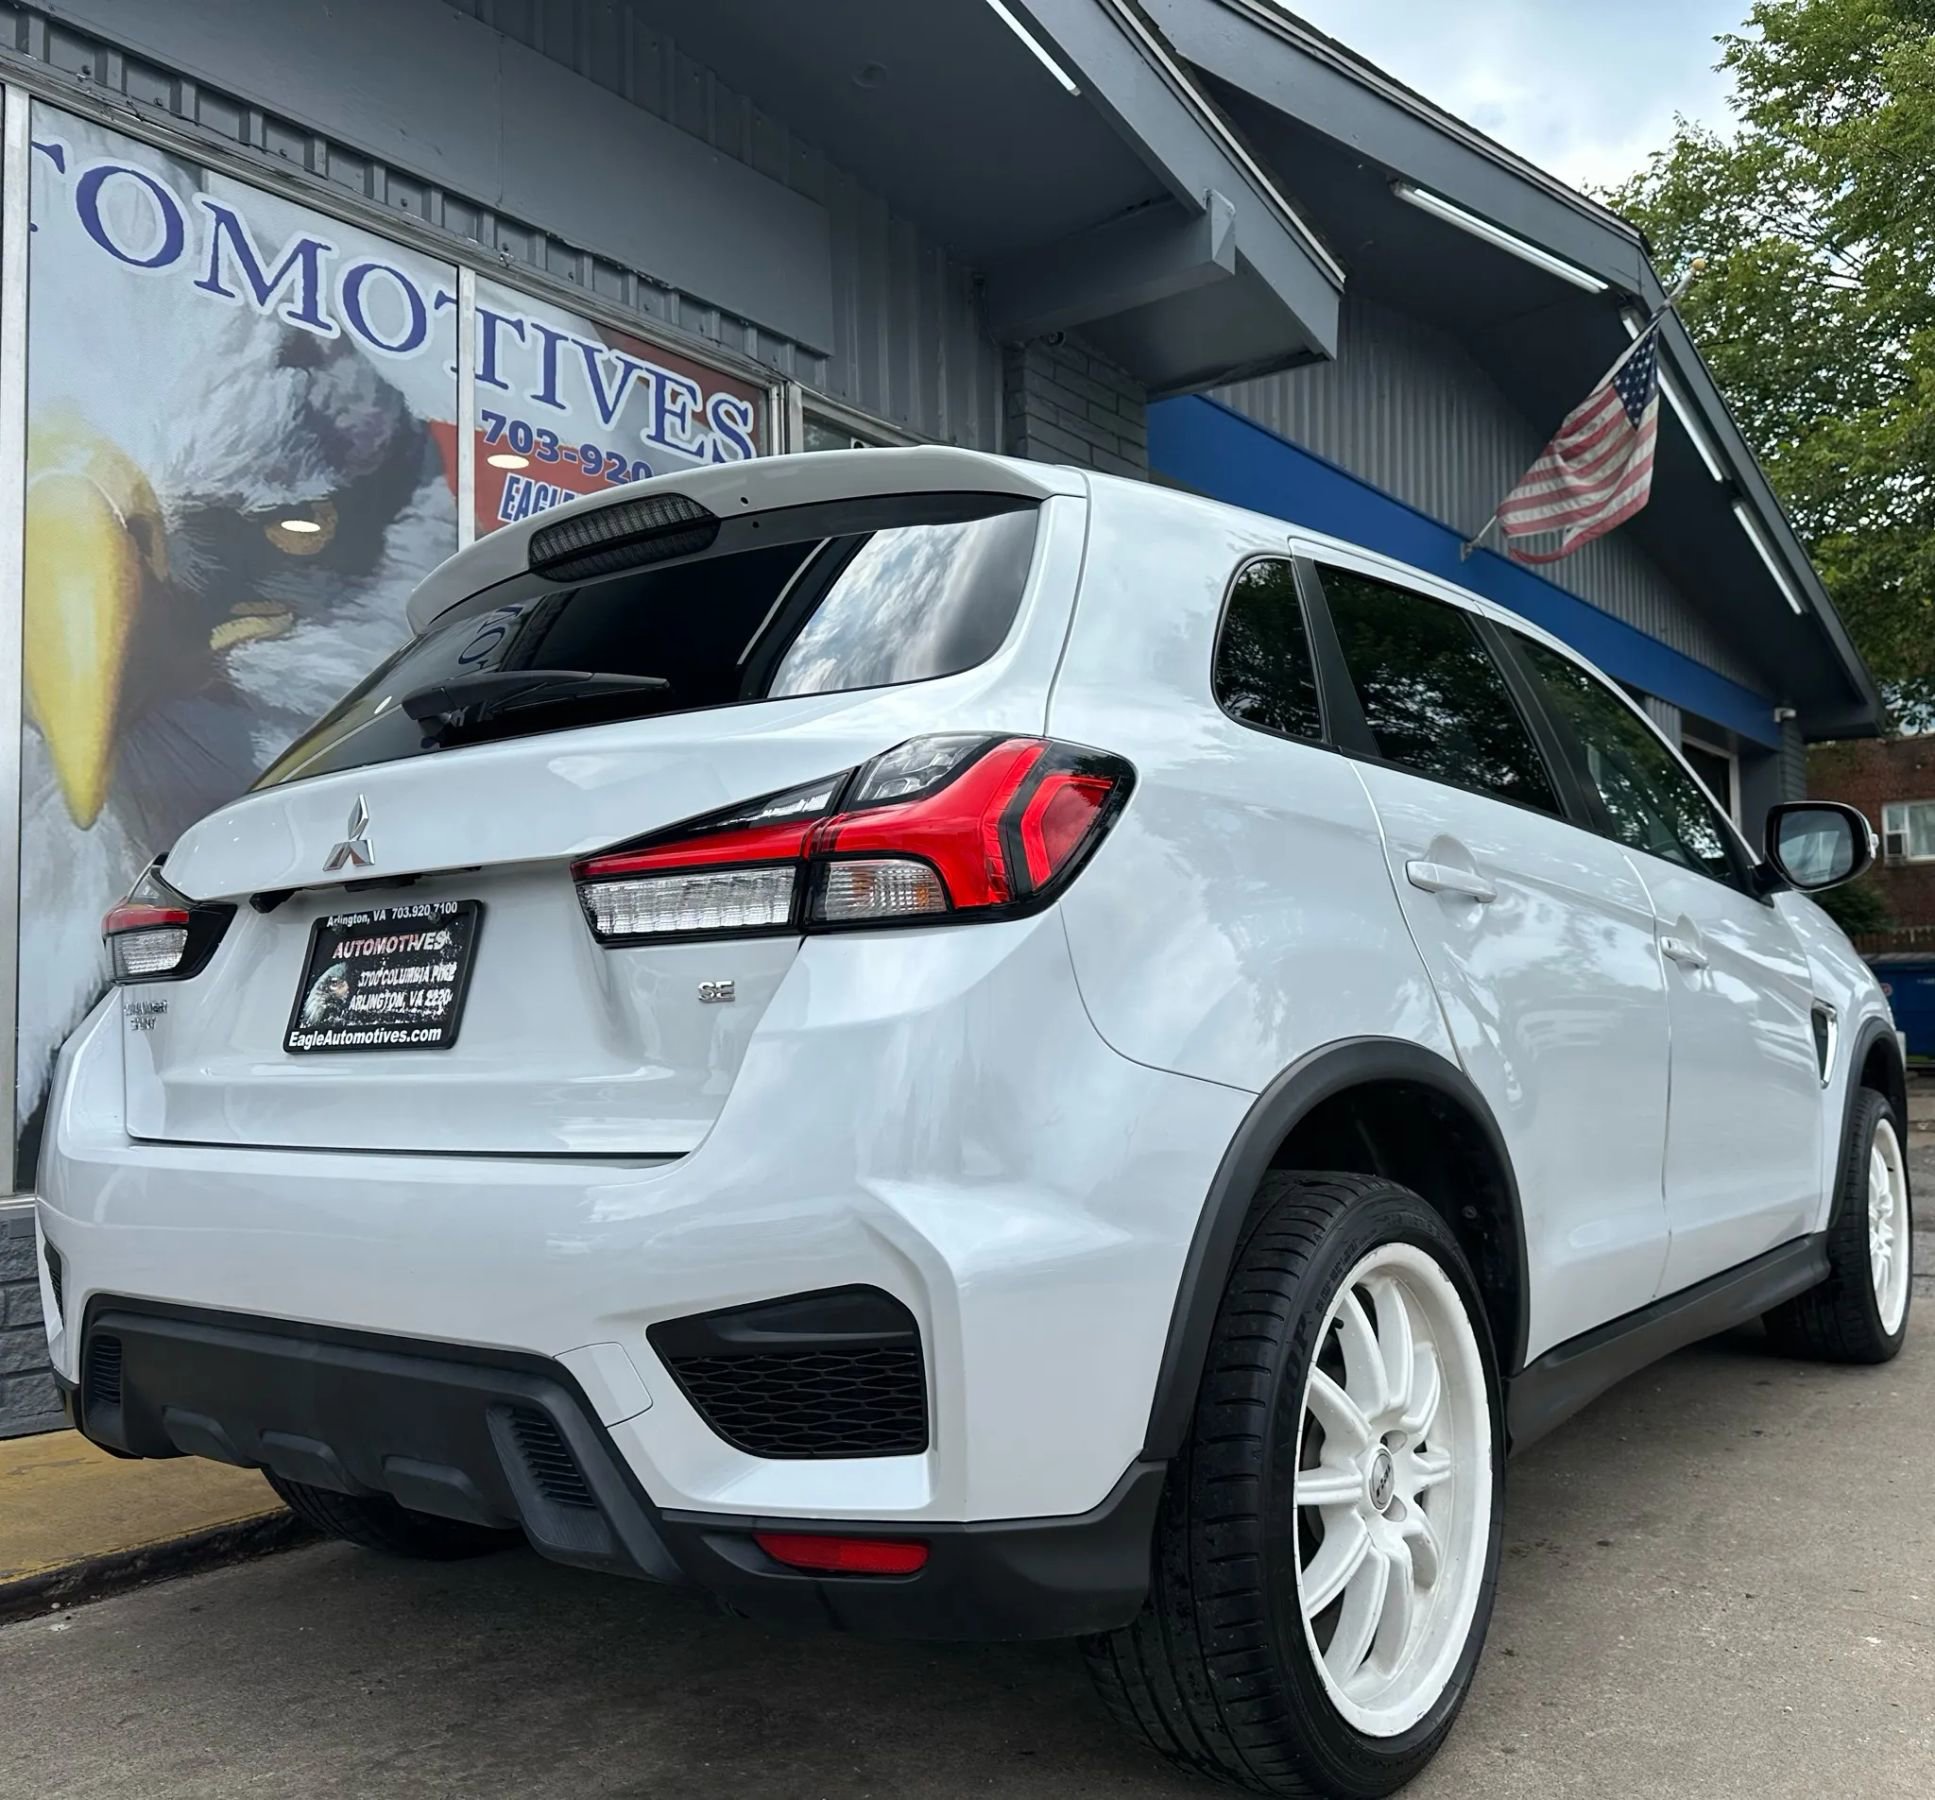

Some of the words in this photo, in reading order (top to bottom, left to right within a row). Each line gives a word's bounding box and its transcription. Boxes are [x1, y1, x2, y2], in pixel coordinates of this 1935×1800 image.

[31, 139, 754, 463] OMOTIVES
[373, 910, 386, 921] VA
[332, 930, 448, 959] AUTOMOTIVES
[409, 989, 425, 1007] VA
[698, 980, 735, 1003] SE
[289, 1027, 442, 1050] EagleAutomotives.com
